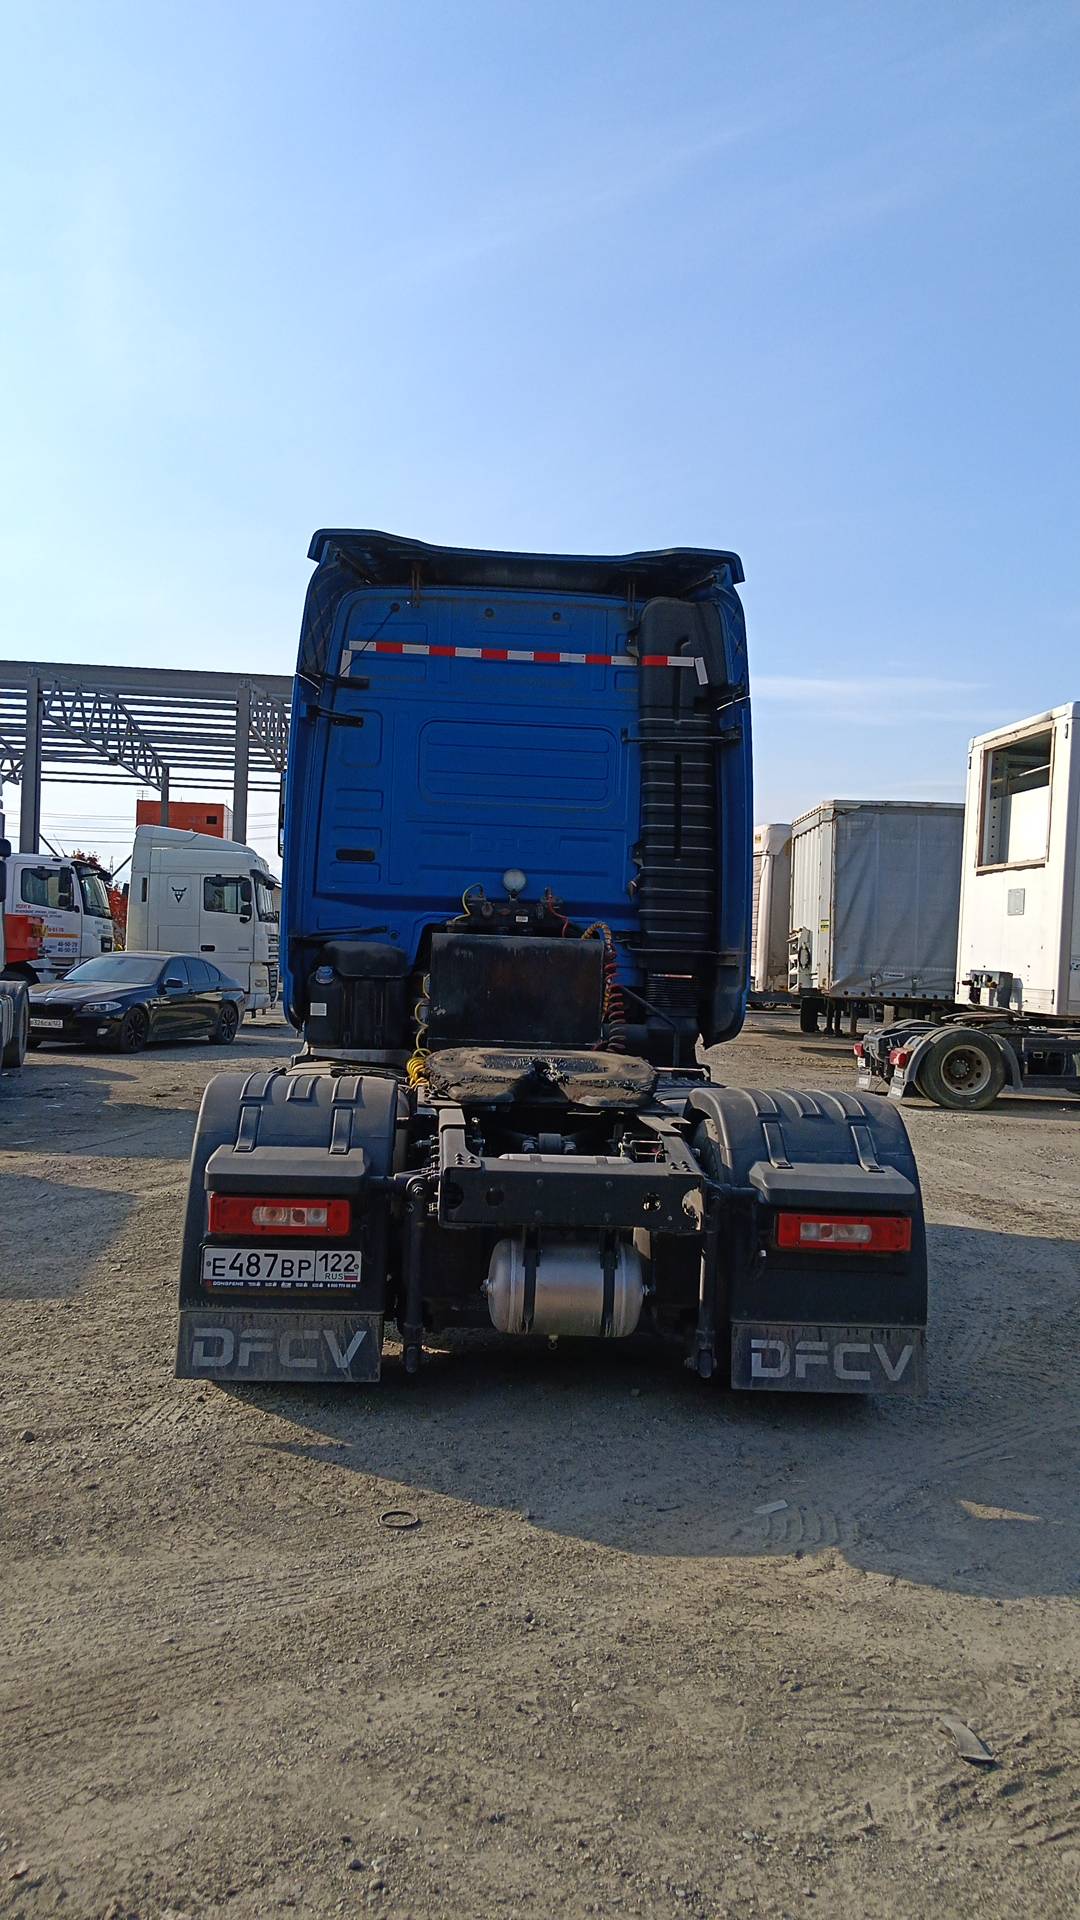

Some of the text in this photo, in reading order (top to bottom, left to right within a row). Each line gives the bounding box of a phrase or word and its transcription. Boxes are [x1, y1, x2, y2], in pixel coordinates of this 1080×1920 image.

[318, 1253, 356, 1272] 122
[192, 1328, 367, 1369] DFCV
[751, 1339, 914, 1382] DFCV
